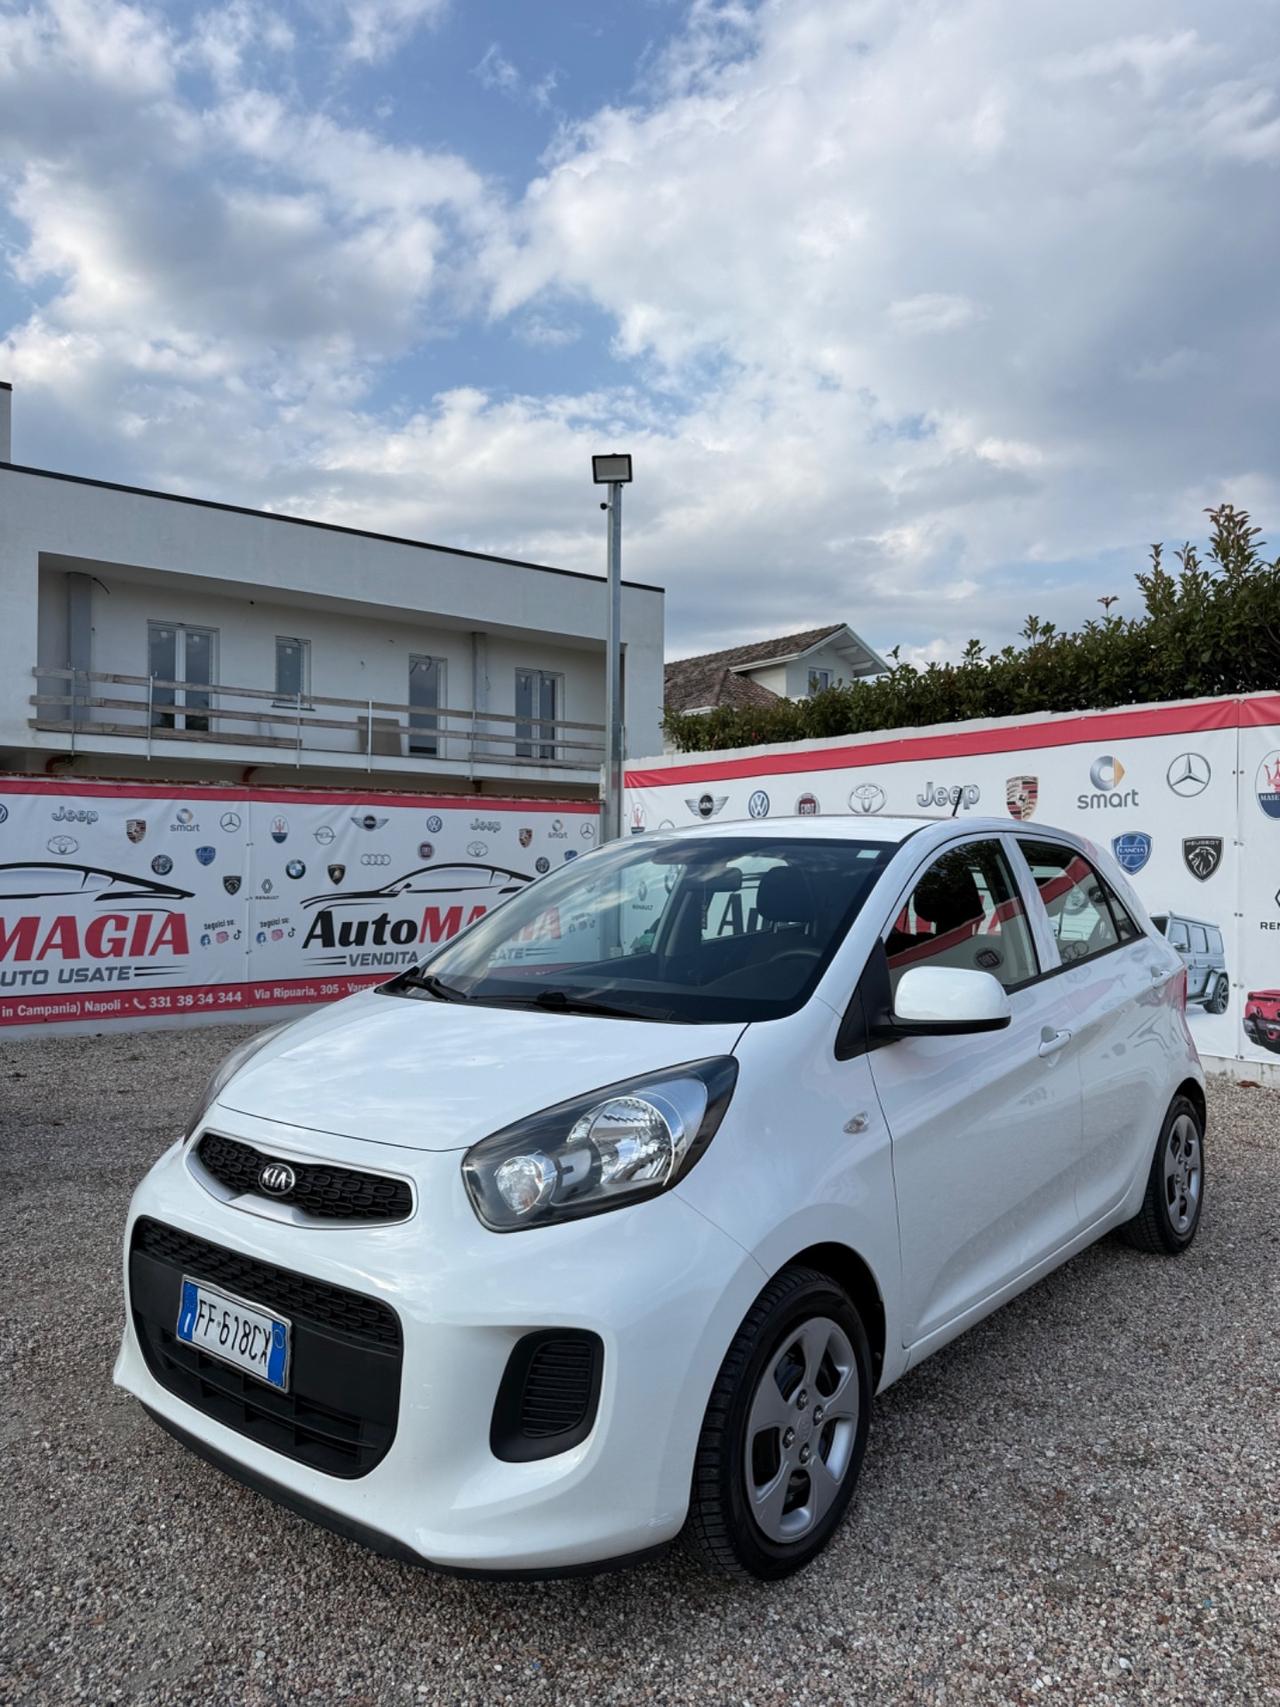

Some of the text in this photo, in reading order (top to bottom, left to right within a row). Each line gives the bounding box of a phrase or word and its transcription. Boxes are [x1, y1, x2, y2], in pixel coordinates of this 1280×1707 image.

[917, 781, 980, 810] Jeep
[1077, 789, 1139, 810] smart
[51, 806, 99, 825] Jeep
[170, 824, 200, 832] smart
[470, 818, 502, 833] Jeep
[349, 951, 418, 967] VENDITA
[0, 966, 132, 987] UTO USATE
[254, 987, 271, 999] Via
[273, 985, 317, 998] Ripuaria,
[320, 984, 339, 995] 305
[2, 992, 242, 1017] in Campania) Napoli 331 38 34 344
